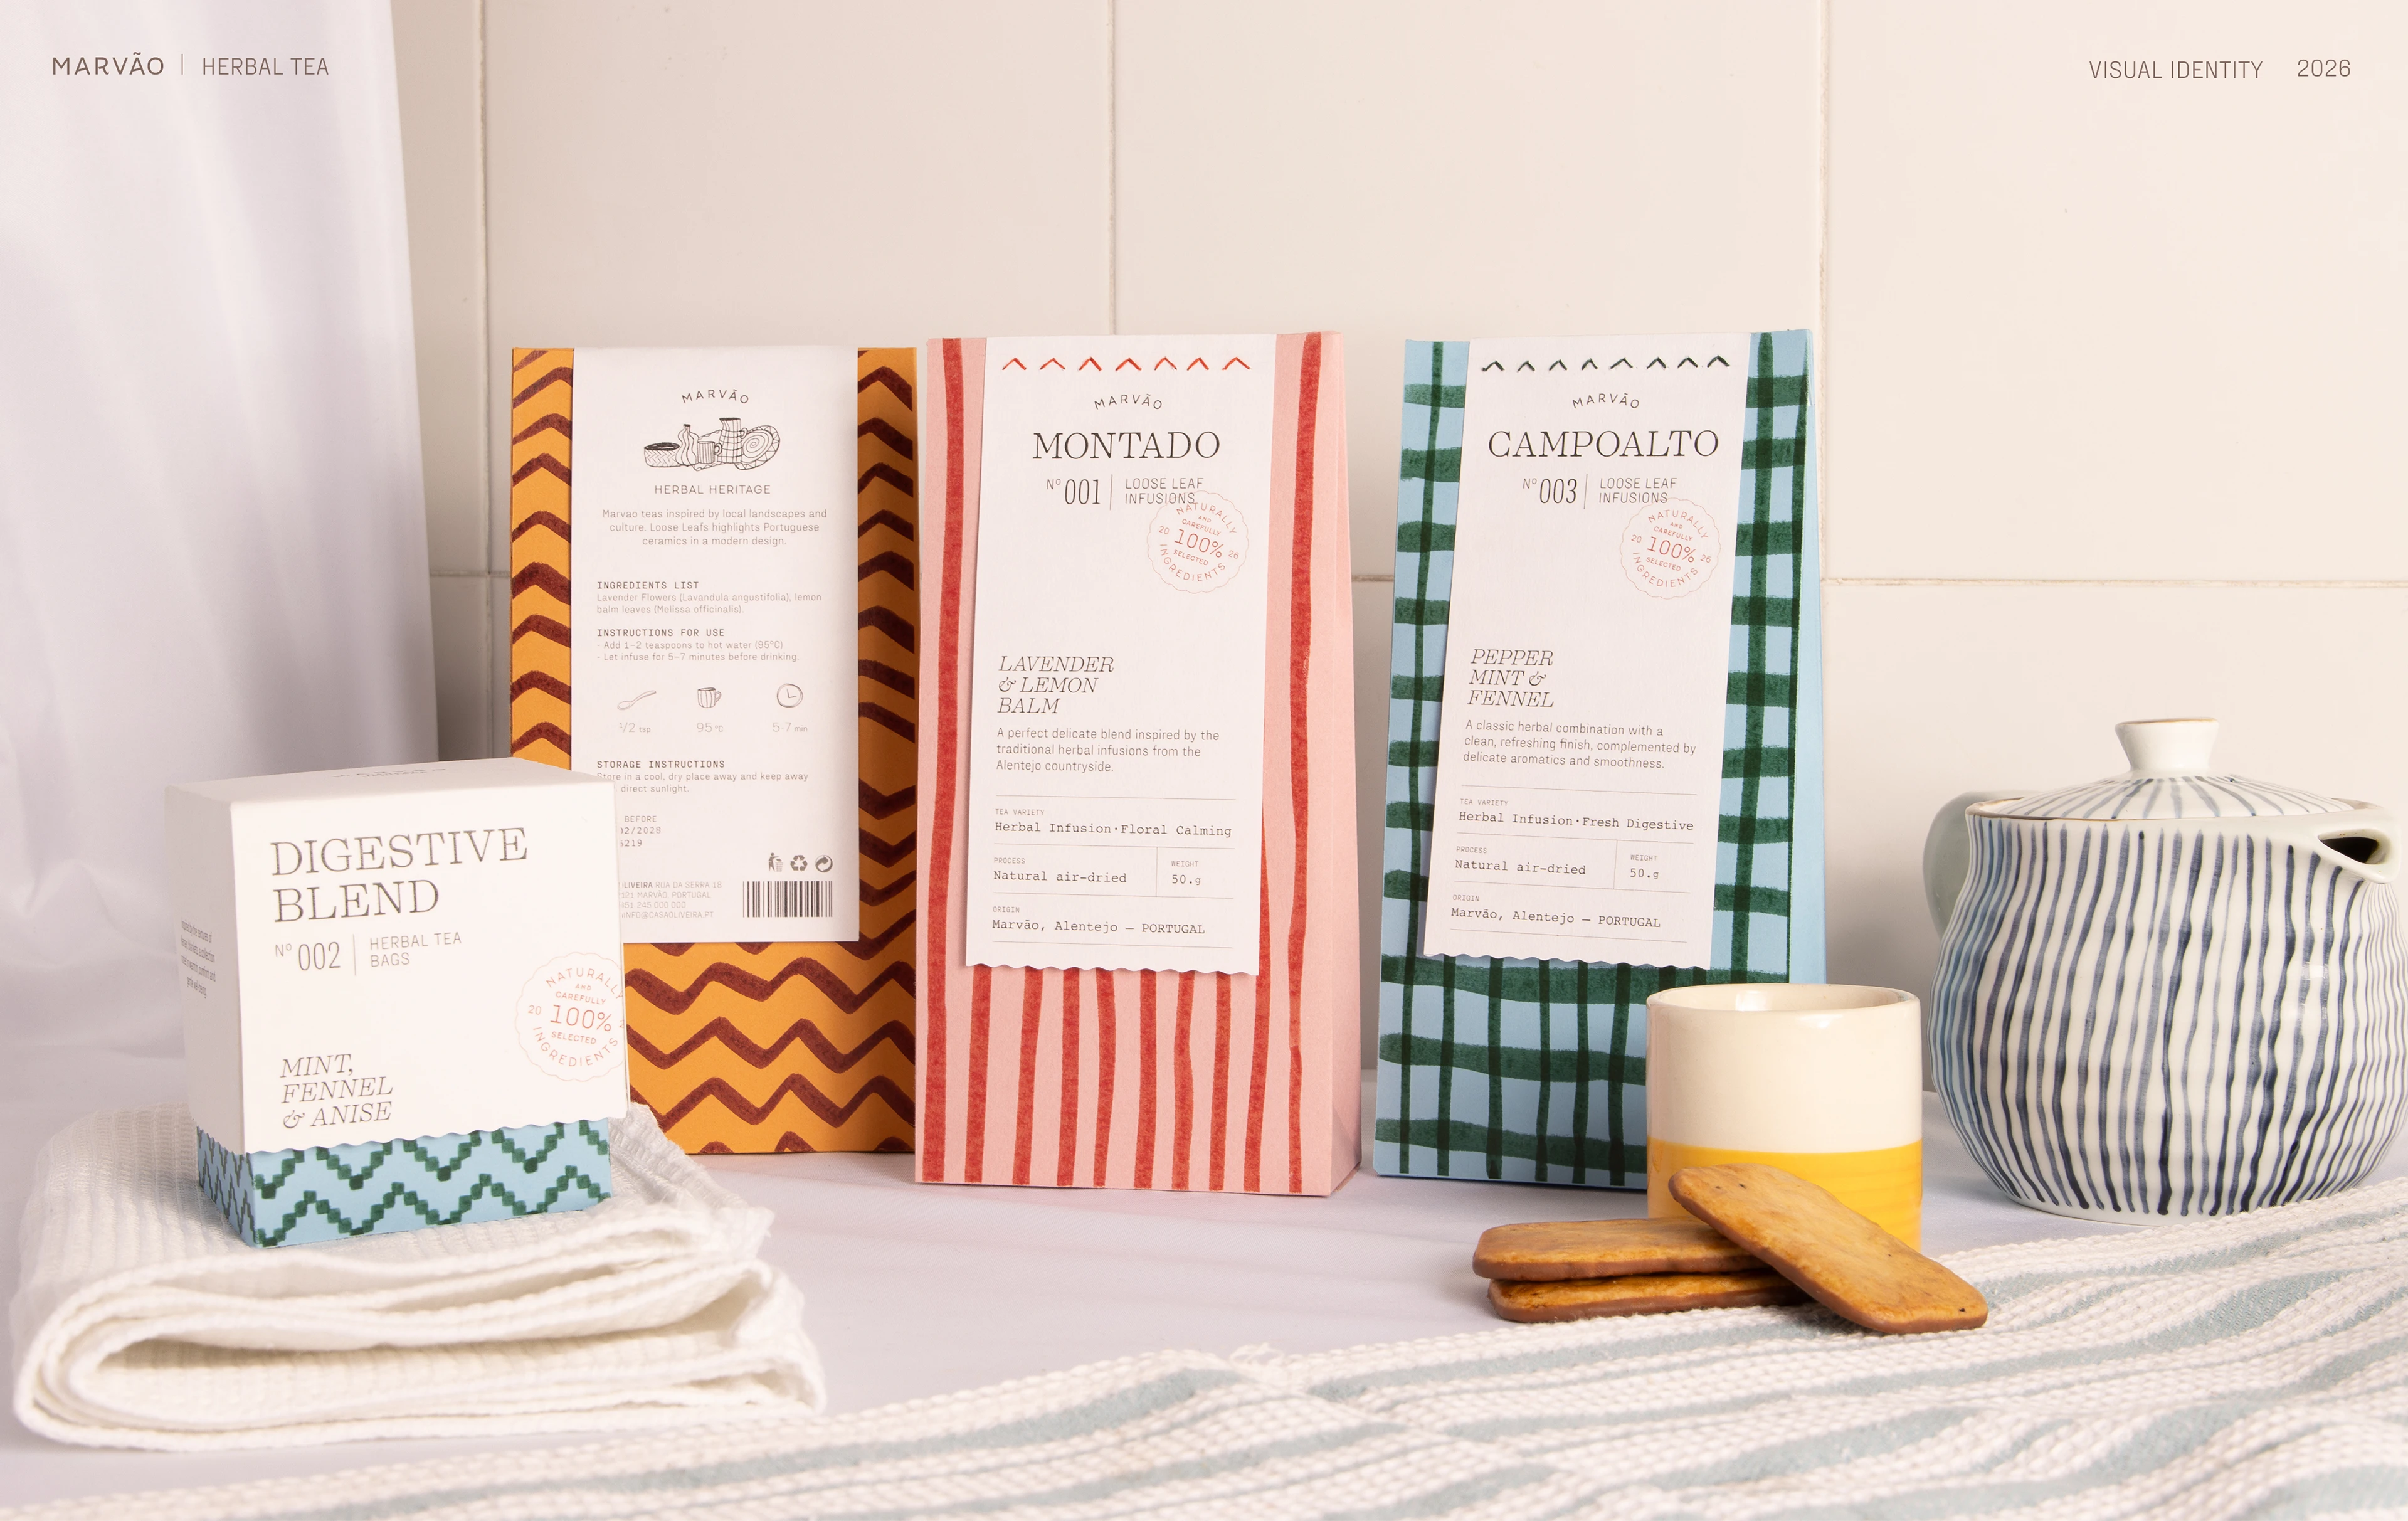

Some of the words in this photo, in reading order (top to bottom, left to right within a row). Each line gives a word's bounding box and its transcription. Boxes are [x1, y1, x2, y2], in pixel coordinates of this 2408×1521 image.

[682, 389, 748, 403] MARVÃO
[1094, 394, 1162, 410] MARVÃO
[1573, 393, 1639, 408] MARVÃO
[1033, 432, 1220, 459] MONTADO
[1489, 430, 1718, 457] CAMPOALTO
[655, 485, 704, 494] HERBAL
[710, 485, 770, 494] HERITAGE
[1065, 479, 1100, 504] 001
[1126, 478, 1166, 489] LOOSE
[1173, 478, 1203, 489] LEAF
[1540, 479, 1577, 503] 003
[1600, 478, 1640, 489] LOOSE
[1646, 478, 1677, 489] LEAF
[1125, 492, 1195, 504] INFUSIONS
[1599, 492, 1668, 503] INFUSIONS
[603, 509, 637, 517] Marvao
[667, 509, 704, 519] inspired
[709, 509, 719, 520] by
[723, 509, 746, 518] local
[750, 509, 805, 519] landscapes
[809, 509, 826, 517] and
[1176, 502, 1237, 534] NATURALLY
[610, 523, 646, 531] culture.
[650, 523, 678, 531] Loose
[683, 522, 708, 531] Leafs
[712, 522, 759, 533] highlights
[764, 523, 819, 533] Portuguese
[1182, 518, 1221, 536] CAREFULLY
[1648, 509, 1708, 538] NATURALLY
[643, 536, 687, 545] ceramics
[691, 536, 699, 544] in
[712, 537, 748, 545] modern
[752, 536, 786, 547] design.
[1654, 526, 1692, 541] CAREFULLY
[1175, 529, 1223, 558] 100%
[1647, 536, 1696, 563] 100%
[1160, 544, 1225, 581] INGREDIENTS
[1173, 549, 1208, 566] SELECTED
[1646, 556, 1681, 571] SELECTED
[1633, 552, 1698, 588] INGREDIENTS
[680, 593, 729, 602] (Lavandula
[732, 593, 791, 603] angustifolia),
[654, 605, 690, 613] (Melissa
[694, 605, 744, 613] officinalis).
[998, 656, 1114, 672] LAVENDER
[1471, 649, 1553, 665] PEPPER
[999, 677, 1016, 692] &
[1020, 677, 1099, 692] LEMON
[1469, 670, 1524, 685] MINT
[1529, 671, 1546, 686] &
[998, 698, 1060, 713] BALM
[1467, 690, 1554, 707] FENNEL
[997, 728, 1003, 737] A
[1008, 728, 1048, 739] perfect
[1052, 728, 1097, 739] delicate
[1101, 729, 1131, 739] blend
[1136, 729, 1180, 741] inspired
[1185, 729, 1196, 743] by
[1201, 730, 1219, 740] the
[1466, 720, 1472, 729] A
[1477, 720, 1514, 731] classic
[1519, 721, 1552, 732] herbal
[1556, 723, 1624, 734] combination
[1629, 725, 1652, 735] with
[997, 744, 1054, 754] traditional
[1059, 745, 1093, 755] herbal
[1098, 745, 1148, 756] infusions
[1153, 745, 1178, 756] from
[1183, 746, 1200, 756] the
[1465, 736, 1496, 748] clean,
[1501, 737, 1555, 751] refreshing
[1560, 738, 1592, 751] finish,
[1597, 741, 1679, 753] complemented
[1684, 743, 1696, 756] by
[996, 760, 1041, 773] Alentejo
[1045, 761, 1113, 773] countryside.
[1464, 751, 1506, 763] delicate
[1511, 756, 1565, 765] aromatics
[1570, 756, 1590, 765] and
[1594, 757, 1664, 768] smoothness.
[650, 785, 689, 794] sunlight.
[1459, 812, 1504, 822] Herbal
[1627, 819, 1693, 830] Digestive
[996, 822, 1040, 832] Herbal
[1176, 825, 1232, 838] Calming
[270, 827, 527, 876] DIGESTIVE
[1455, 860, 1508, 871] Natural
[1517, 862, 1585, 874] air-dried
[1630, 868, 1659, 879] 50.g
[994, 871, 1047, 881] Natural
[1057, 872, 1126, 882] air-dried
[1172, 874, 1200, 885] 50.g
[273, 880, 438, 922] BLEND
[1452, 908, 1502, 920] Marvão,
[1513, 911, 1574, 925] Alentejo
[1598, 916, 1660, 927] PORTUGAL
[993, 920, 1044, 931] Marvão,
[1055, 921, 1117, 933] Alentejo
[1142, 924, 1205, 933] PORTUGAL
[370, 935, 428, 950] HERBAL
[434, 932, 461, 945] TEA
[298, 942, 340, 971] 002
[371, 952, 409, 967] BAGS
[546, 967, 623, 999] NATURALLY
[556, 991, 606, 1005] CAREFULLY
[550, 1004, 611, 1031] 100%
[551, 1031, 596, 1044] SELECTED
[533, 1027, 618, 1067] INGREDIENTS
[280, 1054, 352, 1078] MINT,
[281, 1076, 393, 1103] FENNEL
[283, 1110, 305, 1129] &
[310, 1101, 391, 1126] ANISE
